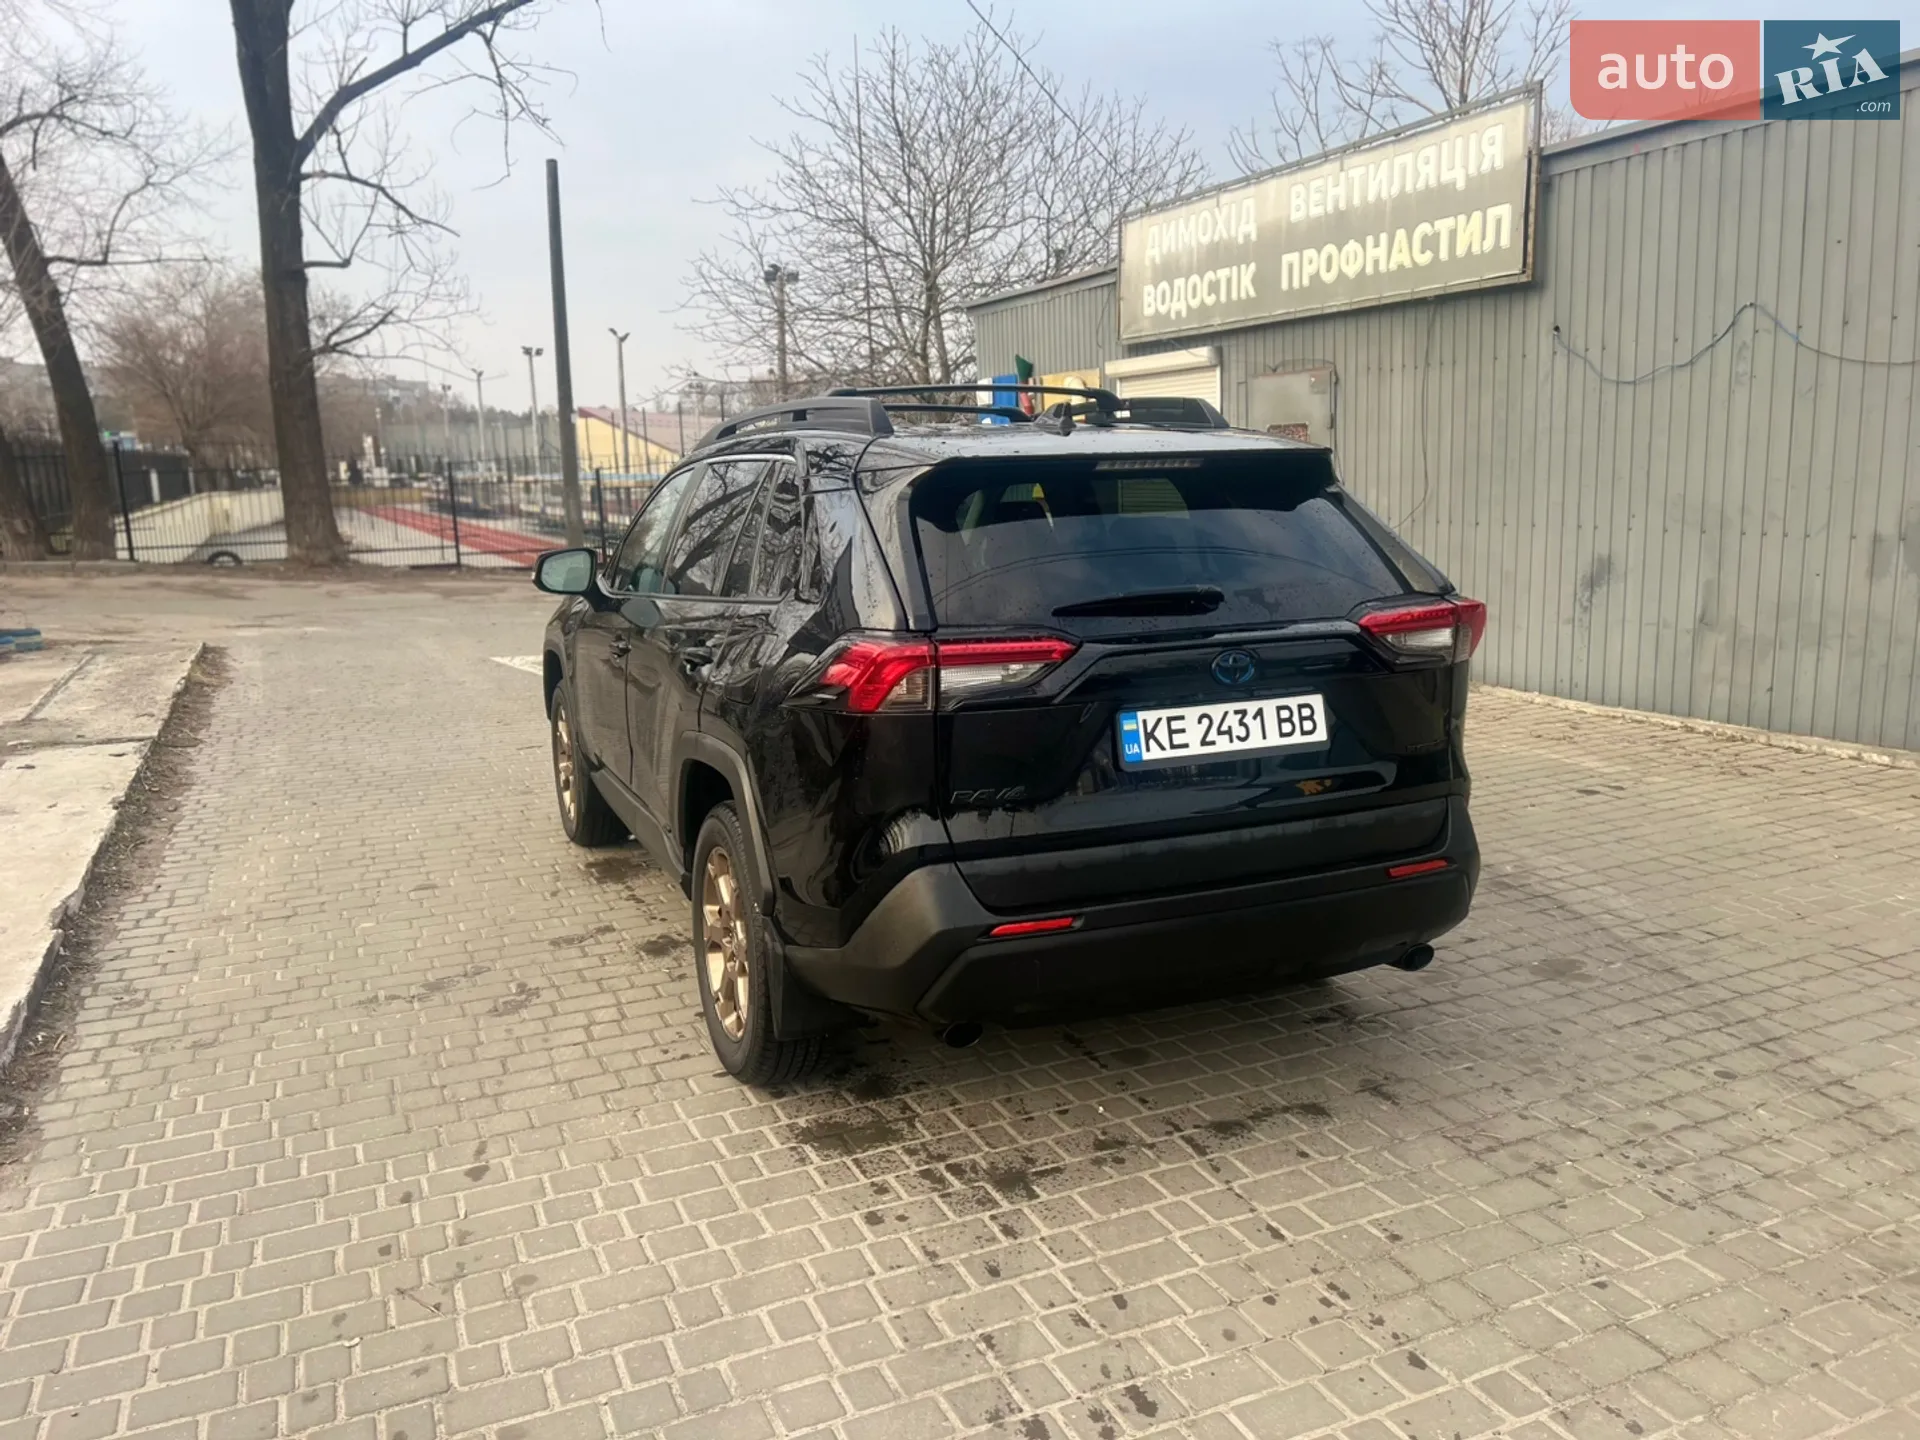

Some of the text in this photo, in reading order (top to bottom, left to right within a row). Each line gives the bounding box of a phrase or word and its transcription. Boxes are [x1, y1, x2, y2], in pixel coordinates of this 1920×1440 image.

[1144, 122, 1505, 267] ДИМОХІД ВЕНТИЛЯЦІЯ
[1142, 202, 1512, 320] ВОДОСТІК ПРОФНАСТИЛ
[1125, 744, 1141, 755] UA
[1142, 703, 1318, 753] KE 2431 BB
